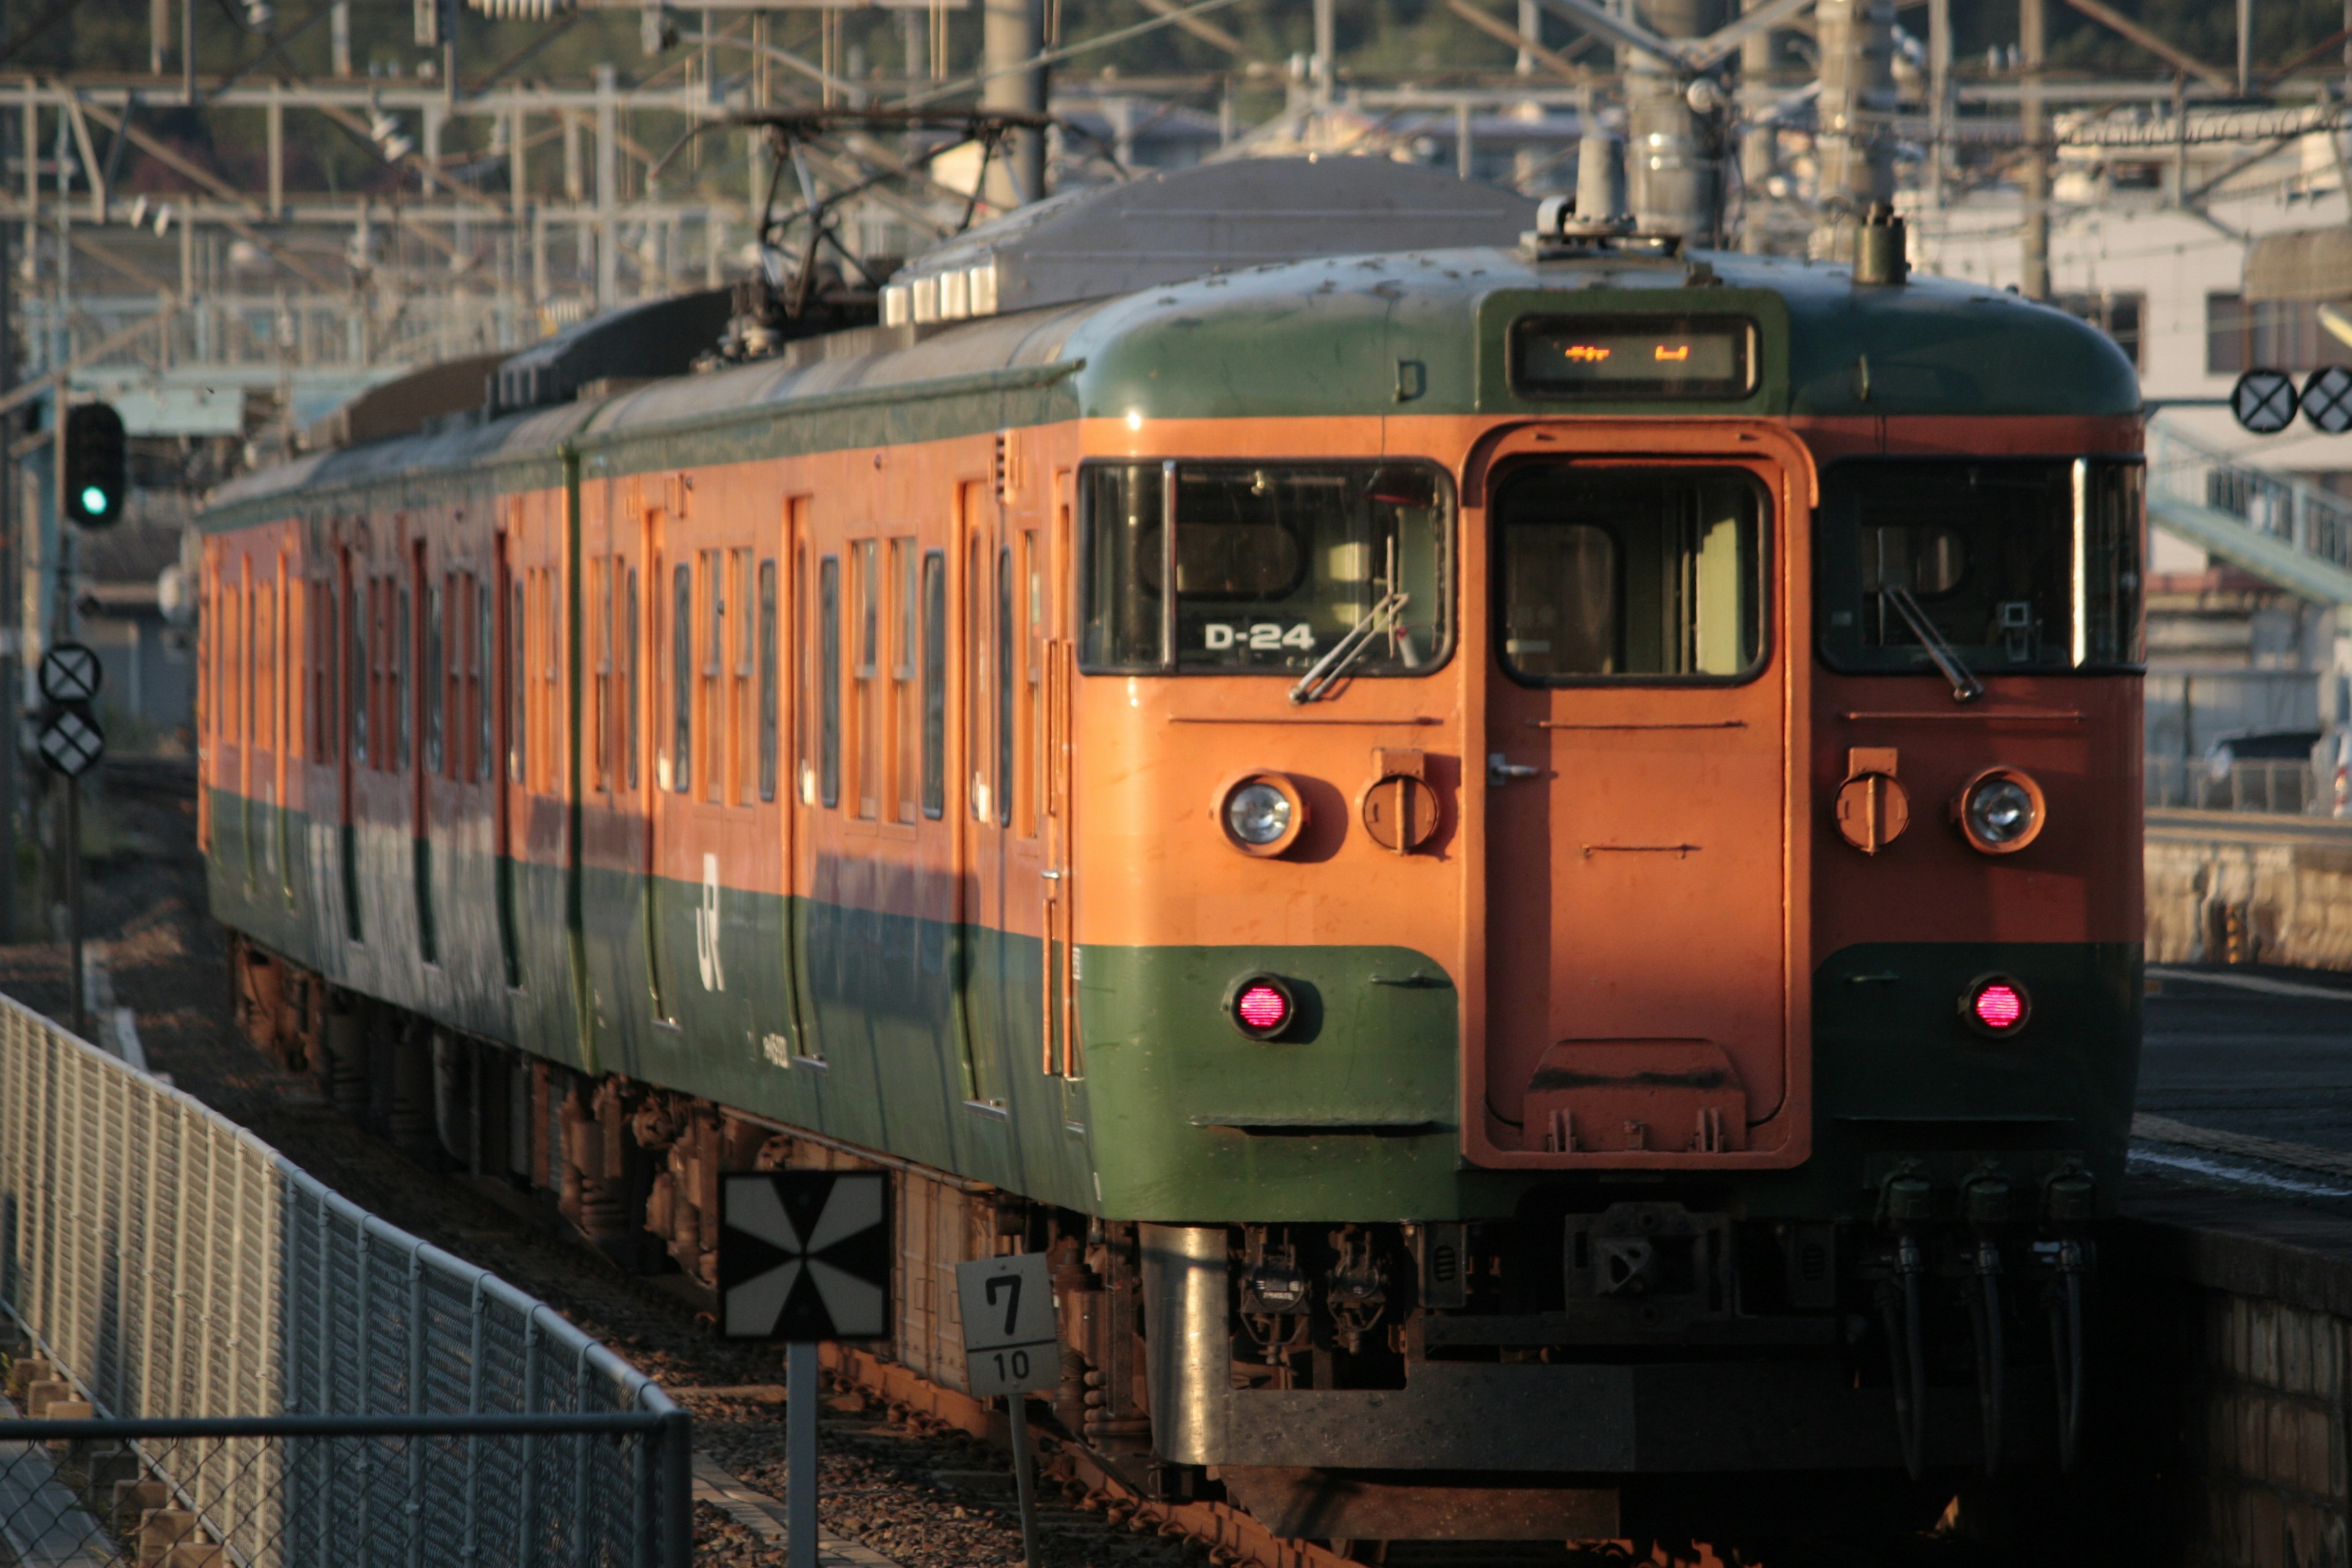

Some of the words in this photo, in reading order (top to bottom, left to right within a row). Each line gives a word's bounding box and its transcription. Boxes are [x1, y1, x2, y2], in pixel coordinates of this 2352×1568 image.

[1205, 623, 1316, 650] D-24
[696, 852, 725, 992] JR
[985, 1275, 1022, 1336] 7
[993, 1349, 1030, 1382] 10
